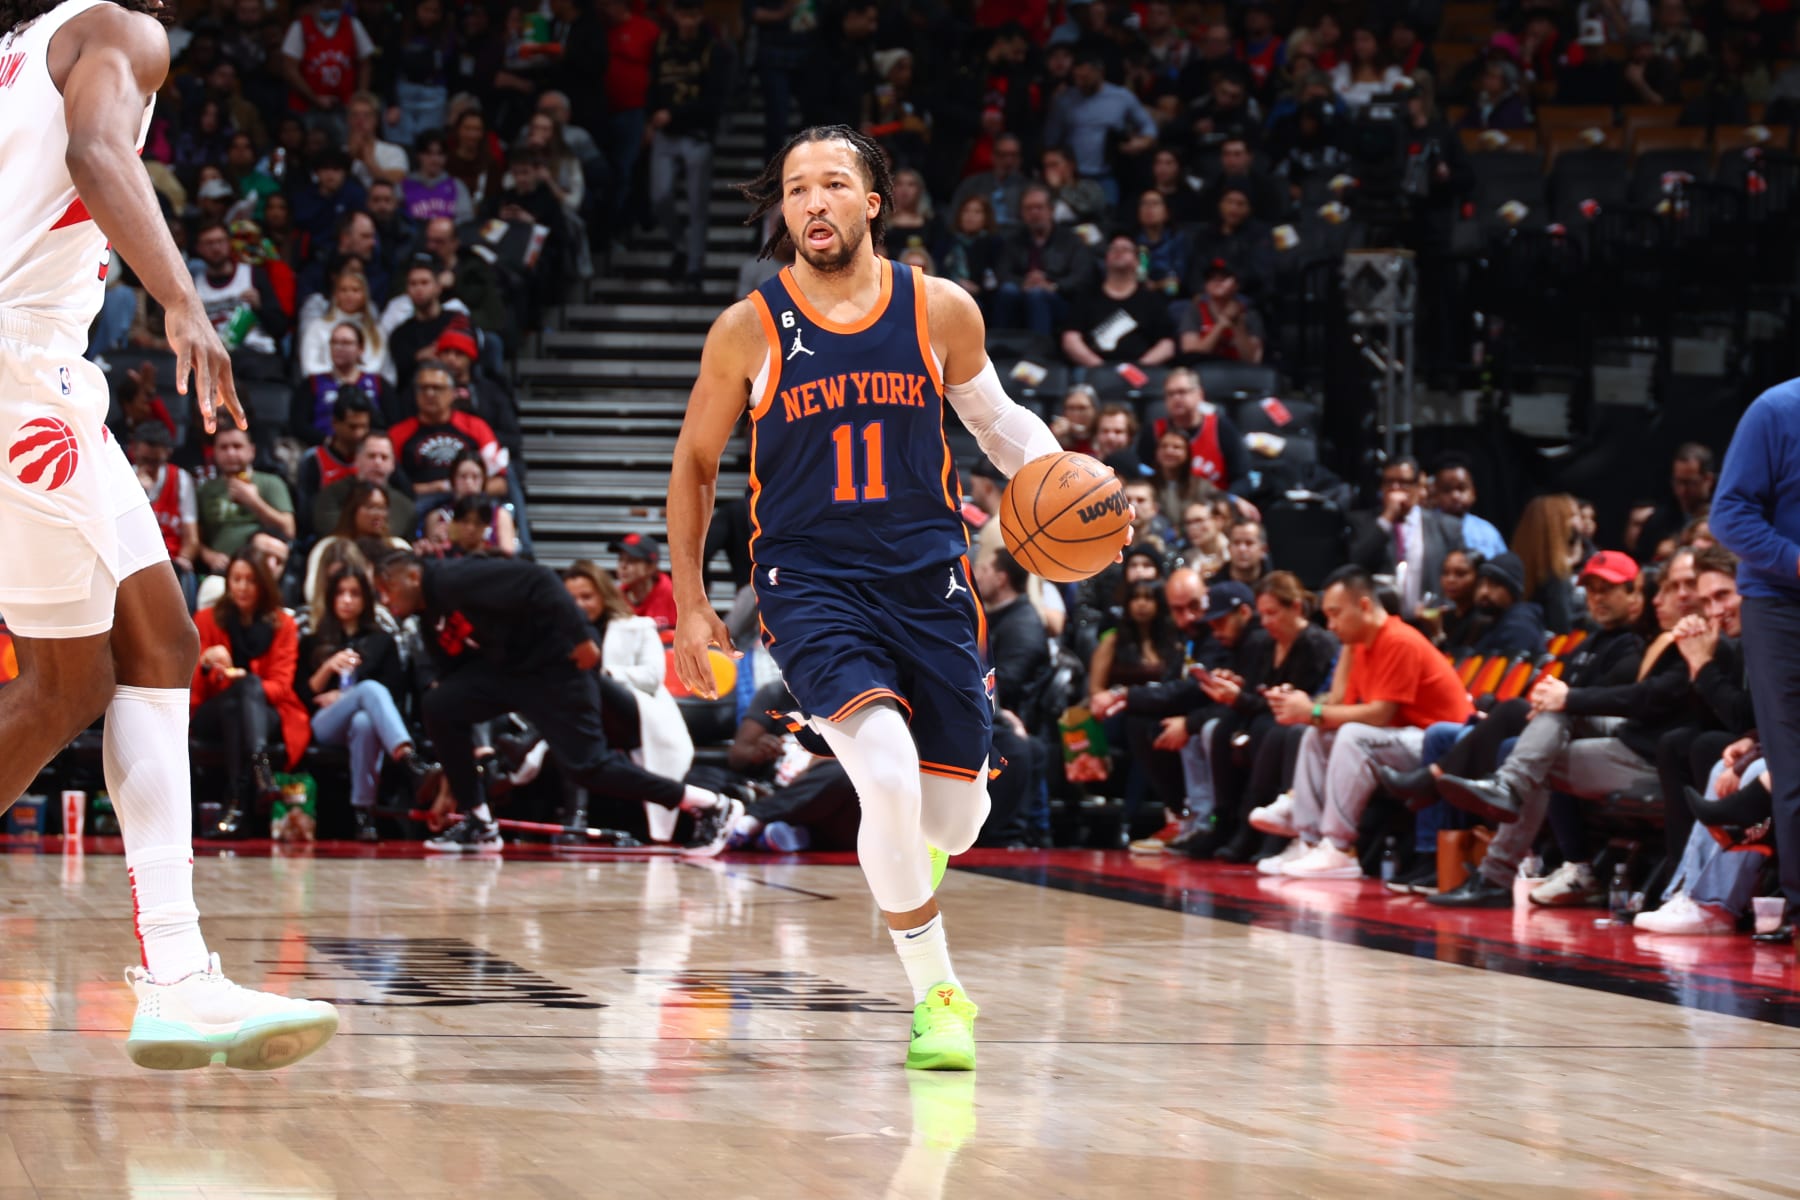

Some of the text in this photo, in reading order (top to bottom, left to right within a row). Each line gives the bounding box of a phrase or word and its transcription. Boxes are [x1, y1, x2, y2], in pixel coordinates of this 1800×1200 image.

[781, 310, 796, 328] 6
[780, 371, 927, 423] NEW YORK
[831, 420, 888, 503] 11
